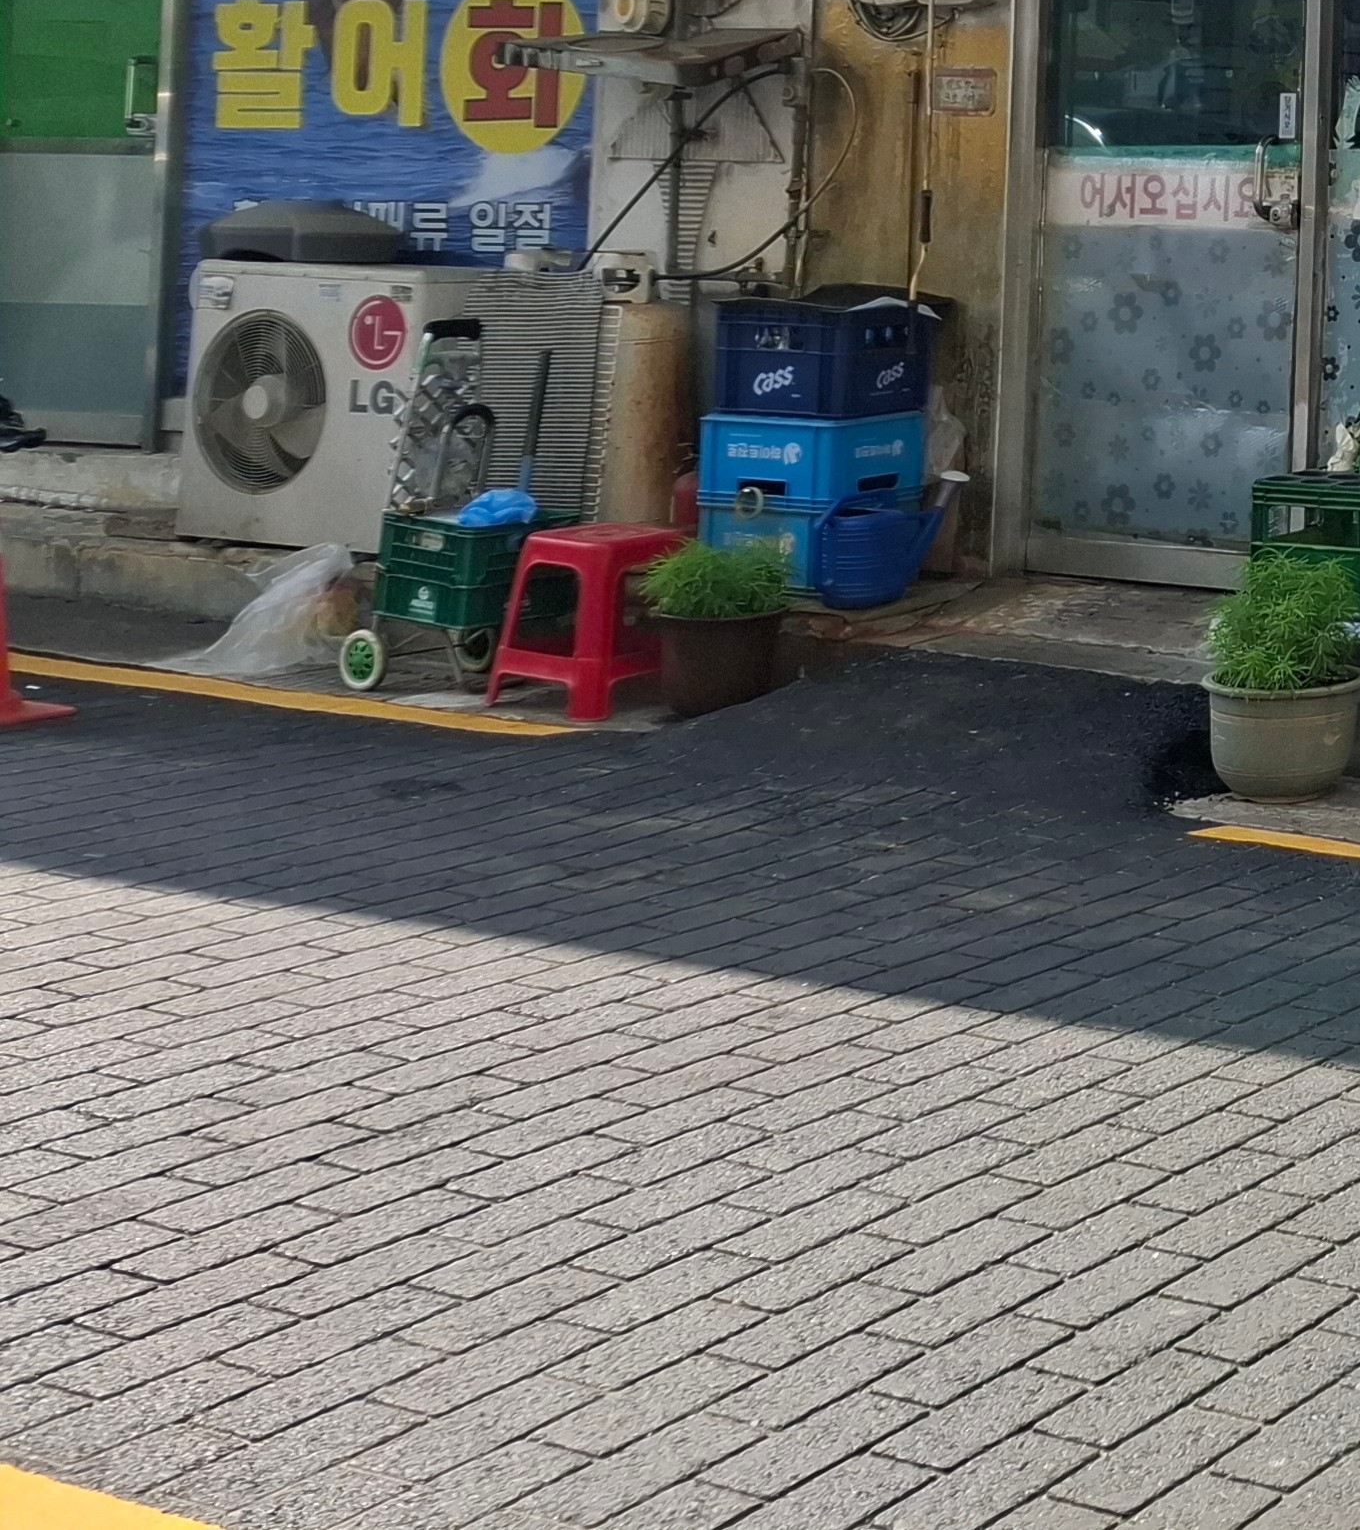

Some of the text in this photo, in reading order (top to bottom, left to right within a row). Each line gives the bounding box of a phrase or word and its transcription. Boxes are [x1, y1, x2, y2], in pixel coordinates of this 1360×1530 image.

[469, 201, 553, 252] 일절
[350, 379, 396, 415] LG
[753, 366, 796, 396] Cass
